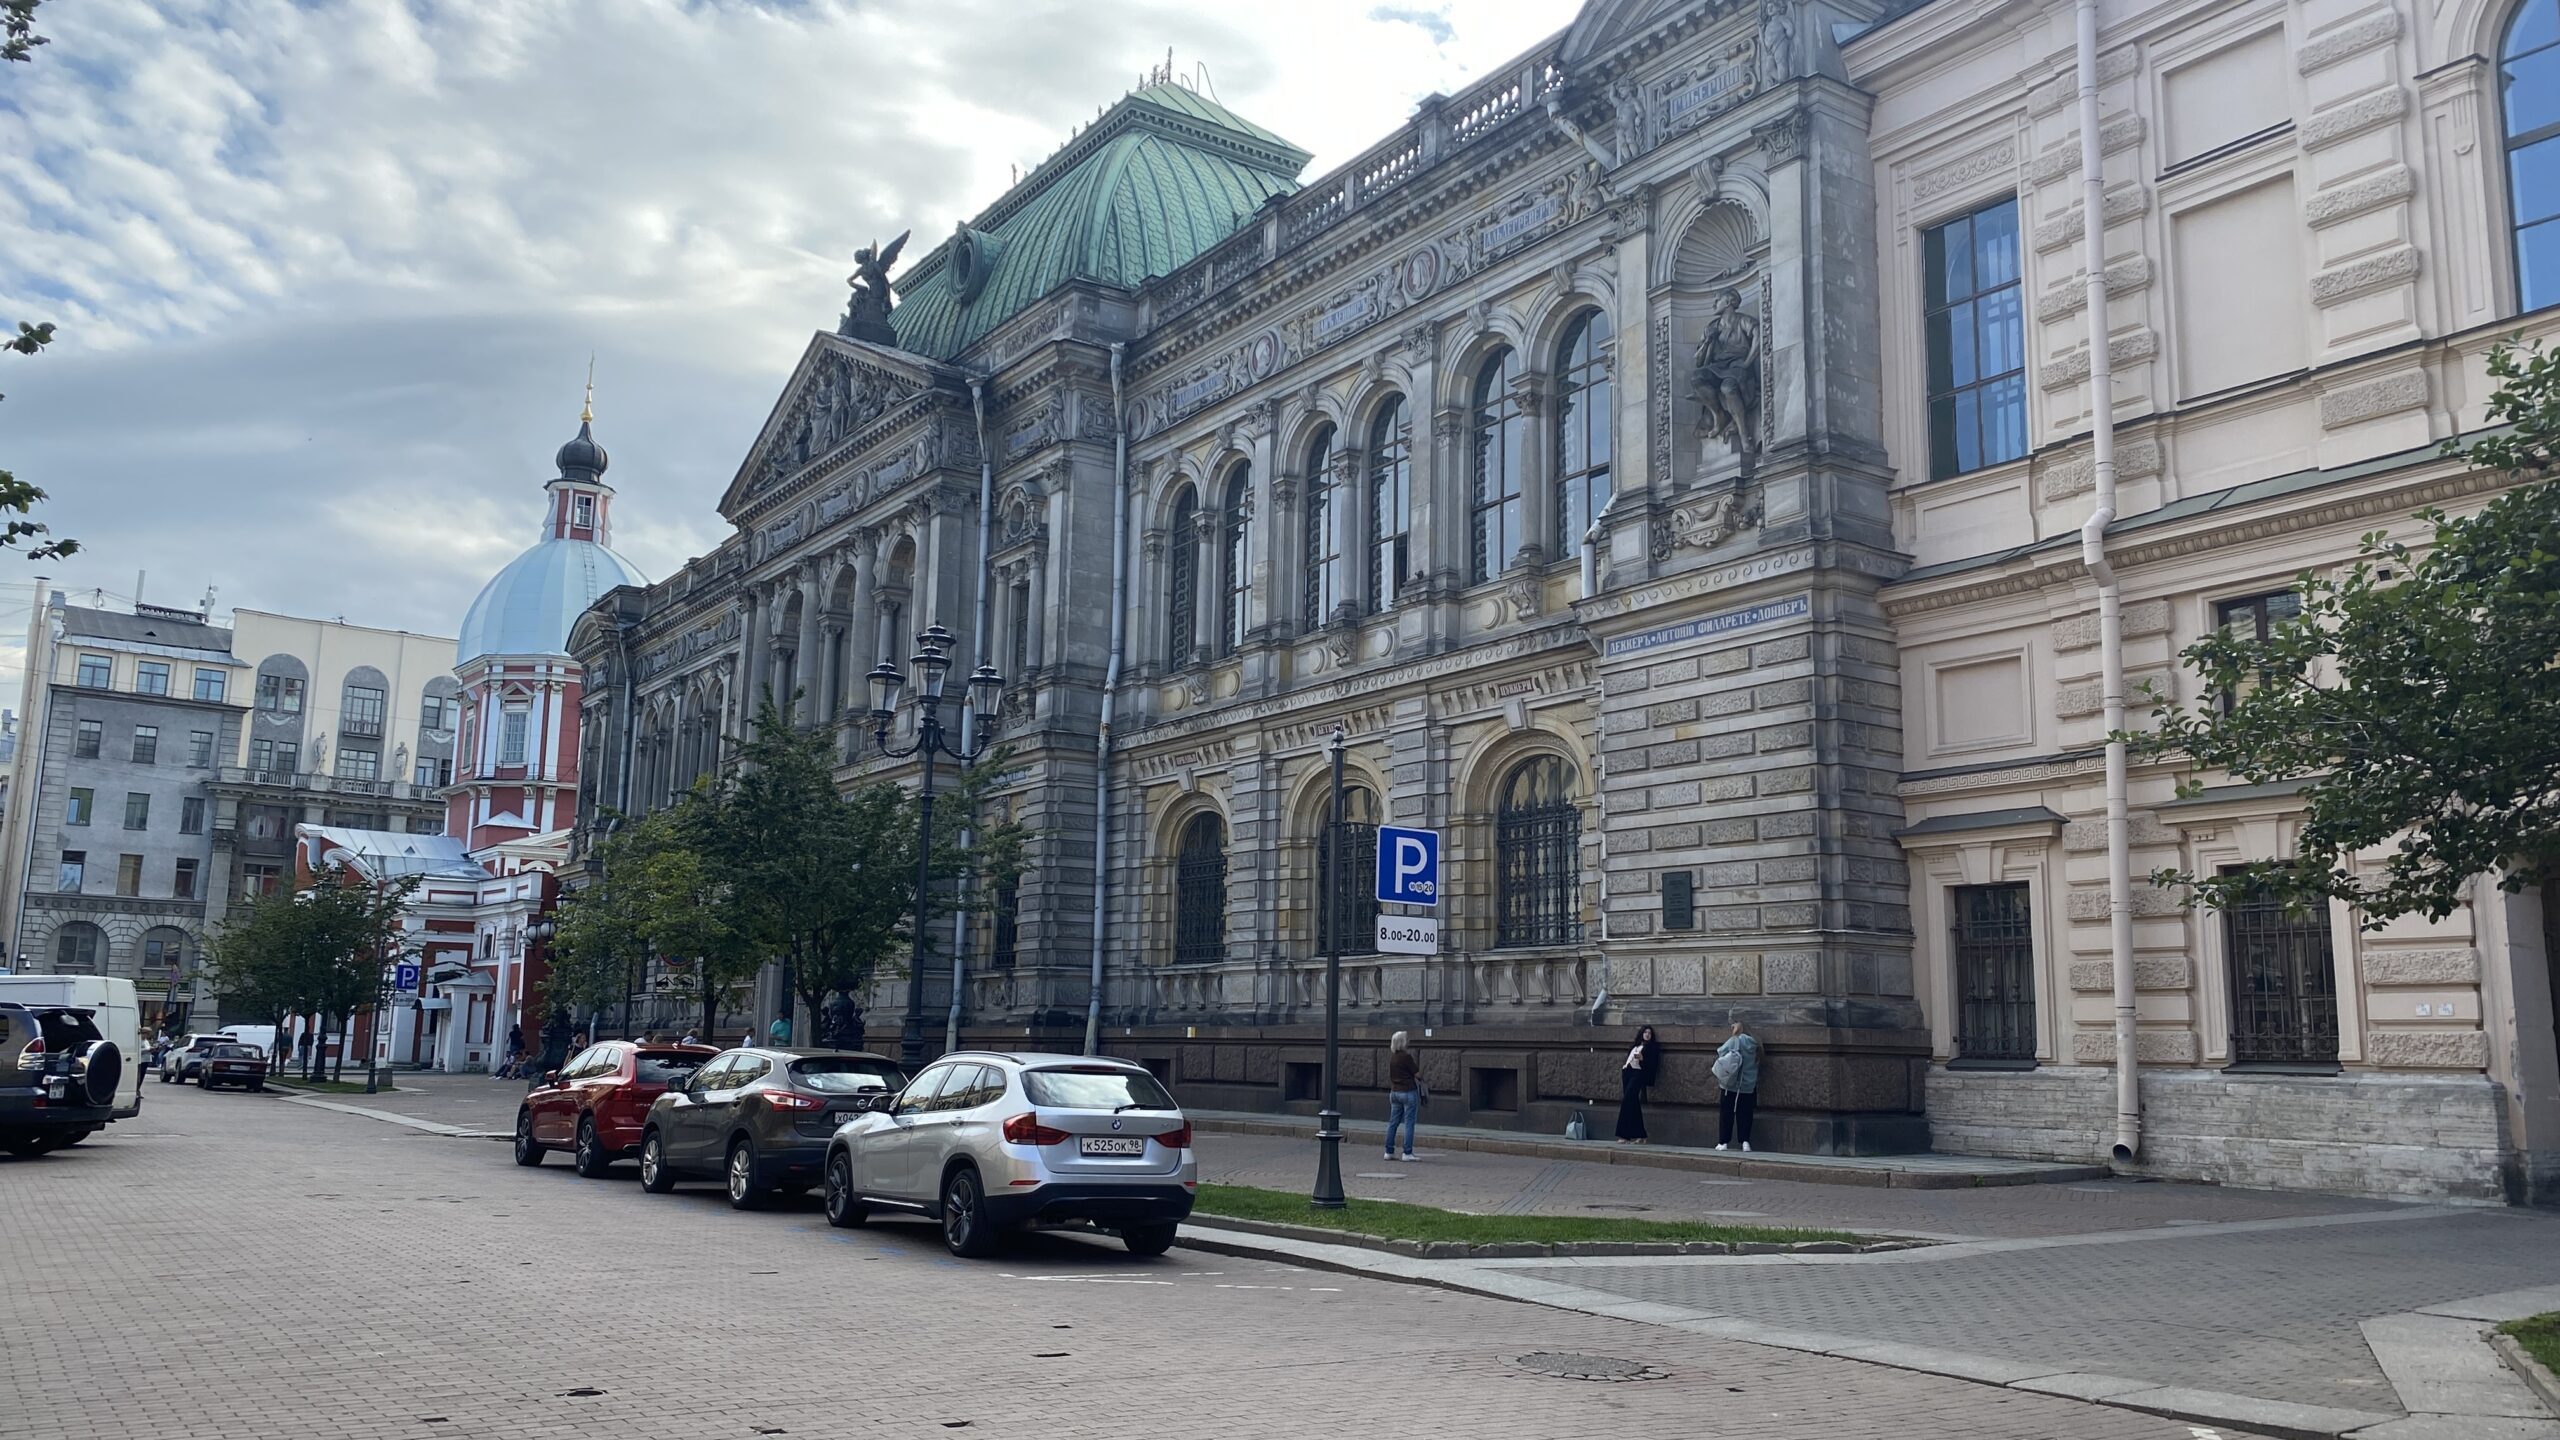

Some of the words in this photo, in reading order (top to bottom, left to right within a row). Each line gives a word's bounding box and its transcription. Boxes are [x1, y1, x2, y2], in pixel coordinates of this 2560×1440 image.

[1609, 635, 1651, 655] ДЕККЕРЪ
[1698, 611, 1751, 634] ФИЛАРЕТЕ
[1757, 599, 1807, 621] ДОННЕРЪ
[1395, 836, 1428, 894] P
[1425, 883, 1434, 893] 20
[1380, 927, 1435, 943] 8.00-20.00
[402, 967, 415, 987] P
